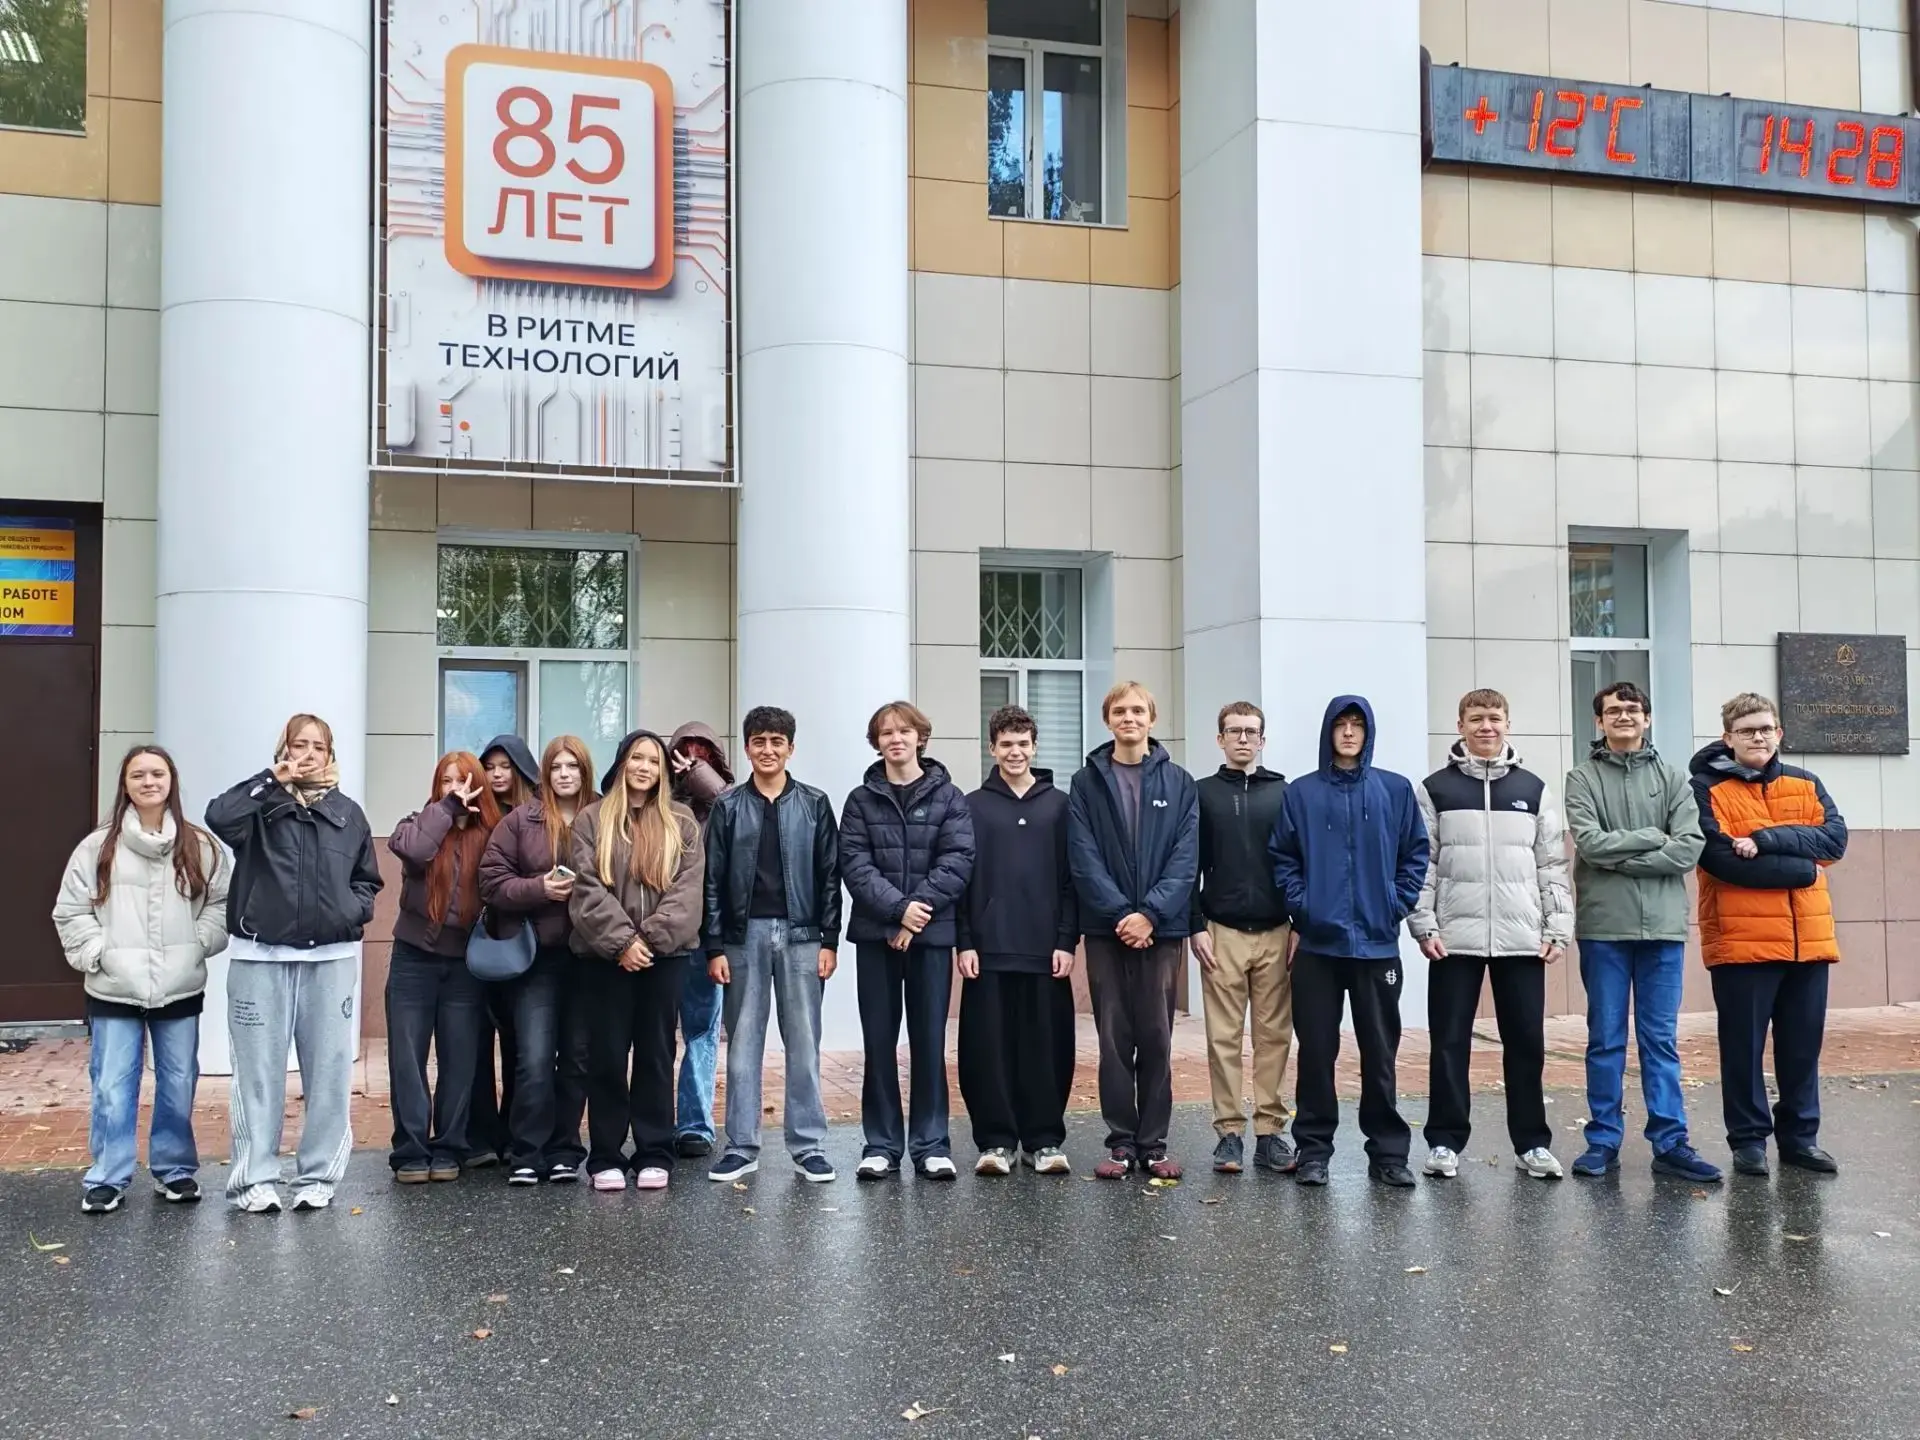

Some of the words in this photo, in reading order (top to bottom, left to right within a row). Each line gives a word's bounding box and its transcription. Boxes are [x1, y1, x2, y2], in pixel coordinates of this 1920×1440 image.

[492, 86, 626, 185] 85
[487, 187, 629, 245] ЛЕТ
[487, 314, 508, 338] В
[517, 316, 636, 347] РИТМЕ
[439, 342, 679, 381] ТЕХНОЛОГИЙ
[3, 587, 59, 601] РАБОТЕ
